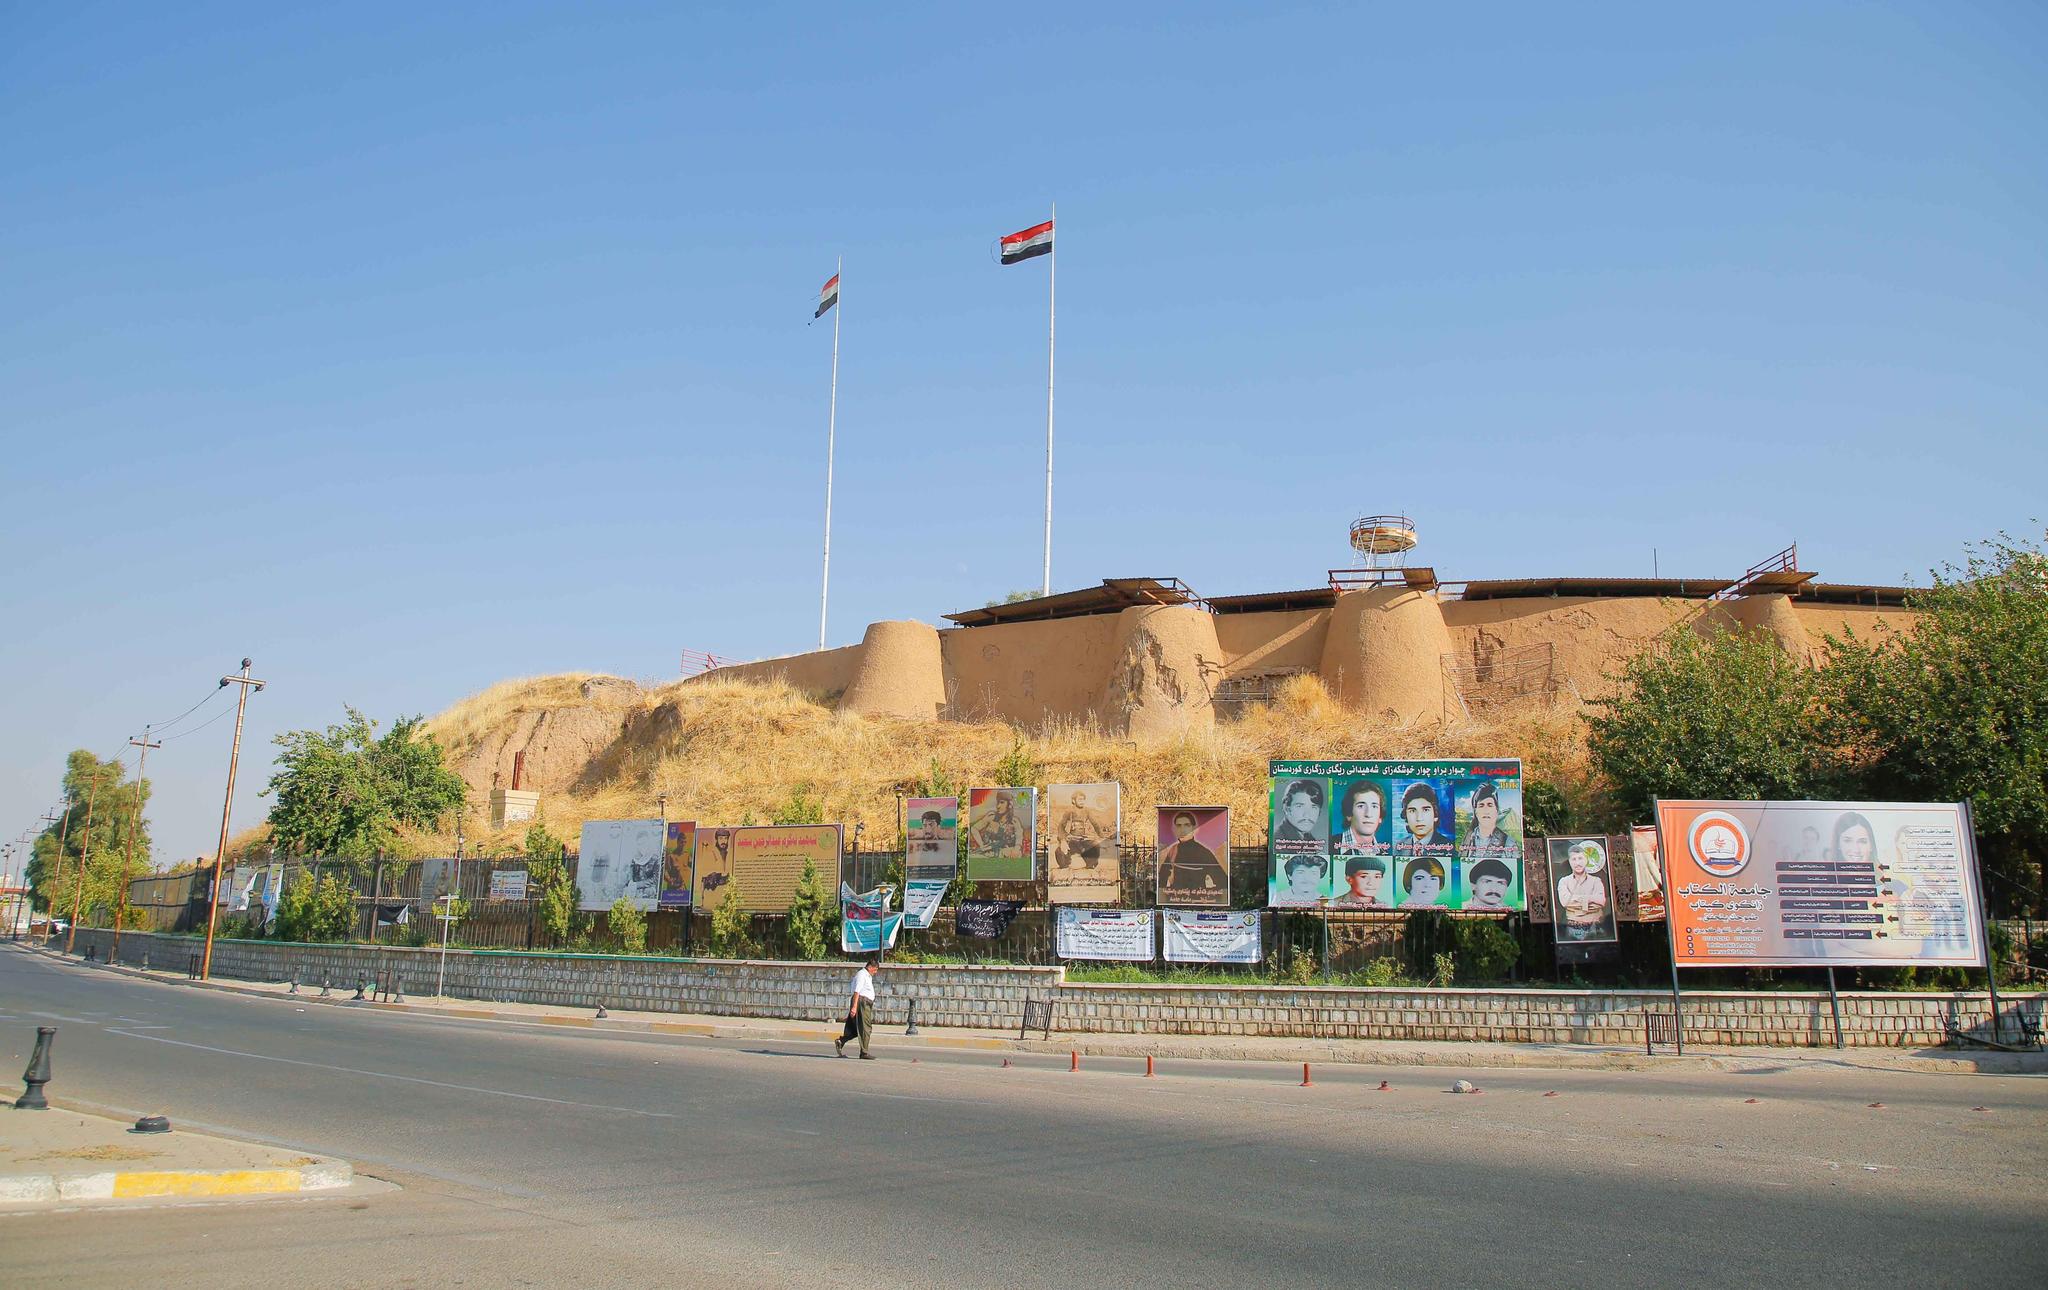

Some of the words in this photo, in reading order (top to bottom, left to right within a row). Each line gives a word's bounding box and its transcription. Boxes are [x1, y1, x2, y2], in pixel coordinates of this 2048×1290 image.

[1272, 764, 1302, 774] کوردستان
[1416, 765, 1431, 778] چوار
[1448, 765, 1466, 778] چوار
[1678, 882, 1728, 898] الكتاب
[1729, 882, 1773, 899] جامعة
